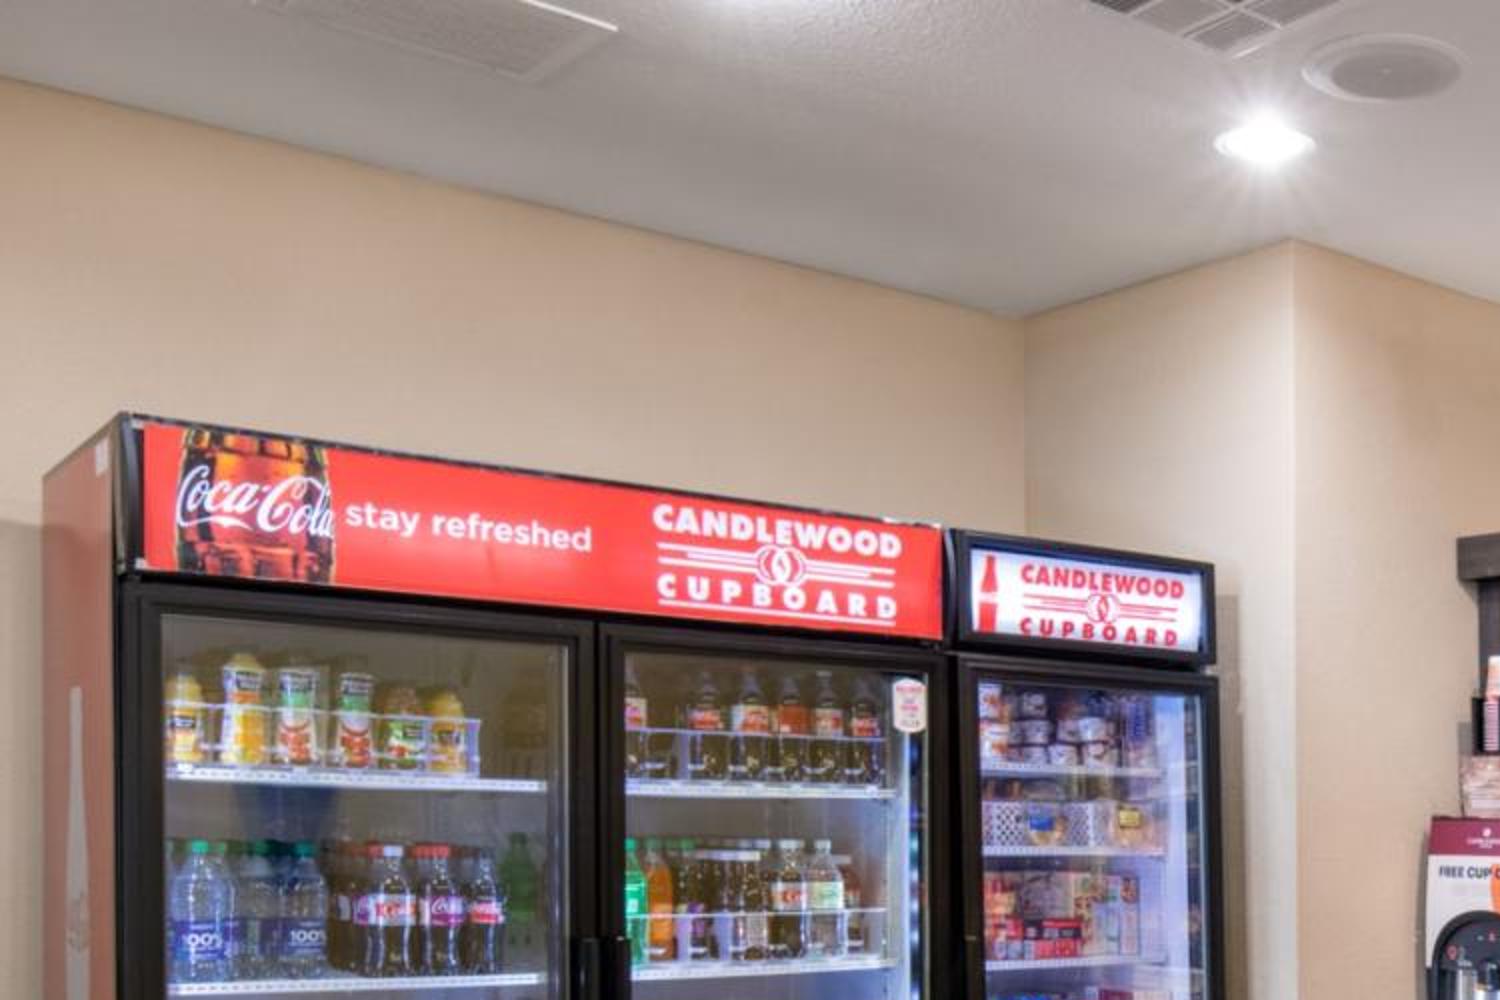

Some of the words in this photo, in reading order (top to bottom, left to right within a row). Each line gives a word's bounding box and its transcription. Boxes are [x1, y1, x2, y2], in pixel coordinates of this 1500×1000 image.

[175, 464, 334, 539] Coca-Cola
[345, 502, 419, 534] stay
[431, 515, 593, 553] refreshed
[652, 503, 903, 558] CANDLEWOOD
[656, 572, 897, 619] CUPBOARD
[1020, 563, 1185, 599] CANDLEWOOD
[1019, 616, 1178, 647] CUPBOARD
